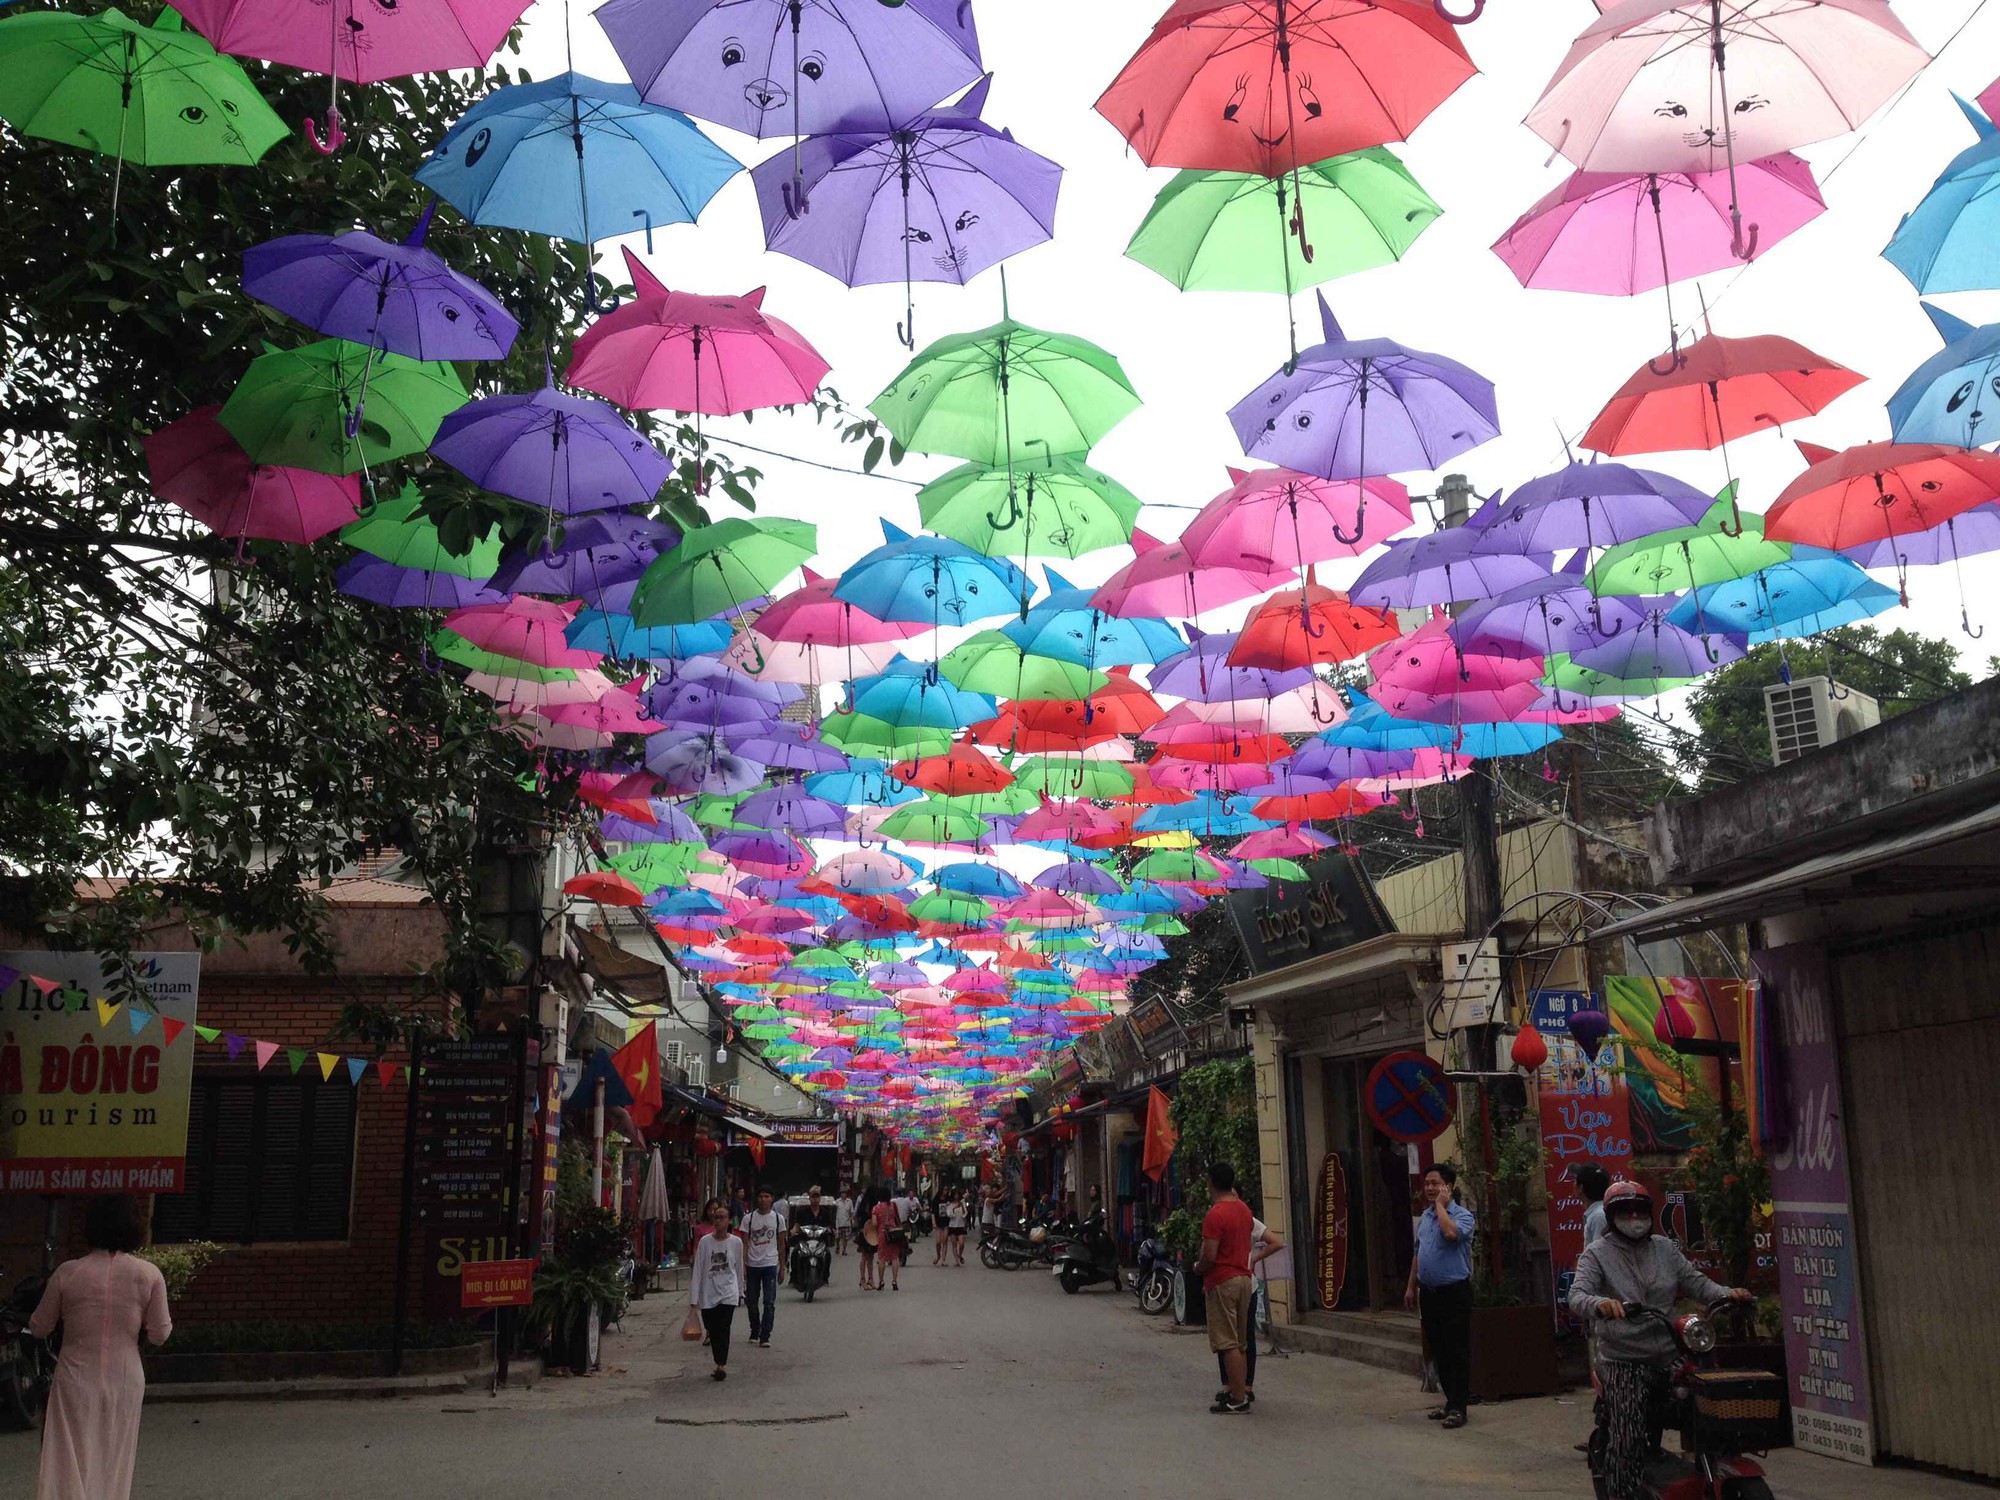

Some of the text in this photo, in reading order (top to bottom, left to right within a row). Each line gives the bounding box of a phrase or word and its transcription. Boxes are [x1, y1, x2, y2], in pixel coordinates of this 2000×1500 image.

[1572, 998, 1578, 1012] 8
[38, 1032, 161, 1094] ĐÔNG
[1558, 1100, 1612, 1131] Vạn
[1544, 1132, 1631, 1158] Phúc
[10, 1170, 45, 1190] MUA
[91, 1161, 124, 1189] SẢN
[1781, 1222, 1843, 1248] BÁN BUÔN
[1793, 1252, 1819, 1276] BÁN
[510, 1276, 528, 1291] NÀY
